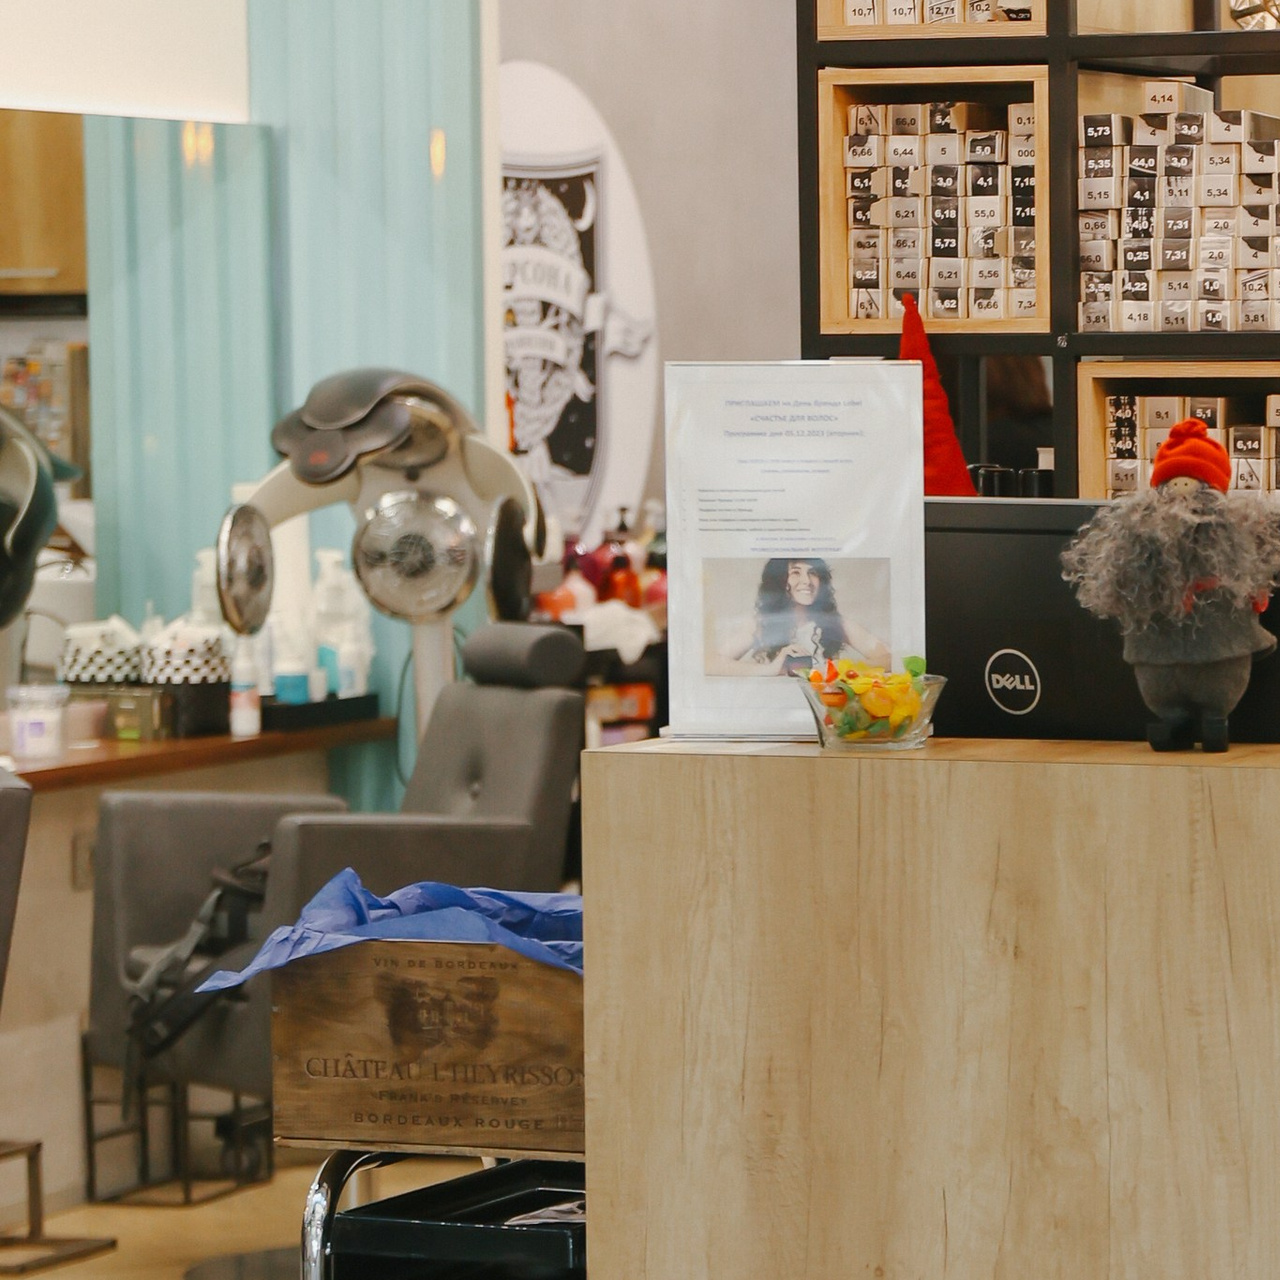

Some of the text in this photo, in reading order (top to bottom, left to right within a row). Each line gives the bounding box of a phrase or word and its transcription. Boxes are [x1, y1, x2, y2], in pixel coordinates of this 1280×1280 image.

[852, 8, 872, 16] 10,7
[893, 8, 913, 16] 10,7
[929, 7, 955, 15] 12,71
[1150, 95, 1173, 104] 4,14
[859, 116, 873, 125] 6,1
[1087, 126, 1110, 138] 5,73
[1150, 129, 1156, 137] 4
[1181, 125, 1199, 136] 3,0
[1224, 125, 1231, 133] 4
[852, 148, 872, 157] 6,66
[893, 148, 913, 157] 6,44
[976, 146, 991, 155] 5,0
[1132, 158, 1155, 168] 44,0
[1172, 157, 1188, 168] 3,0
[1209, 157, 1230, 166] 5,34
[1258, 156, 1264, 164] 4
[1088, 160, 1111, 170] 5,35
[937, 177, 953, 187] 3,0
[977, 177, 992, 186] 4,1
[1014, 178, 1035, 186] 7,18
[1088, 191, 1109, 200] 5,15
[1133, 191, 1149, 201] 4,1
[1168, 189, 1189, 198] 9,11
[1207, 188, 1228, 198] 5,34
[895, 210, 915, 218] 6,21
[935, 209, 956, 218] 6,18
[974, 210, 995, 218] 55,0
[1015, 207, 1035, 216] 7,18
[1085, 221, 1106, 230] 0,66
[1167, 220, 1189, 230] 7,31
[1214, 221, 1229, 230] 2,0
[935, 238, 956, 248] 5,73
[1127, 251, 1149, 262] 0,25
[1165, 251, 1187, 261] 7,31
[1208, 251, 1224, 260] 2,0
[1252, 251, 1258, 259] 4
[856, 271, 877, 280] 6,22
[896, 271, 916, 279] 6,46
[938, 271, 958, 279] 6,21
[979, 270, 999, 278] 5,56
[1168, 282, 1189, 291] 5,14
[1204, 280, 1219, 290] 1,0
[860, 302, 873, 310] 6,1
[935, 300, 957, 309] 6,62
[977, 301, 998, 309] 6,66
[1086, 315, 1107, 324] 3,81
[1128, 313, 1148, 322] 4,18
[1165, 317, 1185, 325] 5,11
[1207, 312, 1222, 322] 1,0
[1244, 314, 1265, 323] 3,81
[1156, 411, 1169, 420] 9,1
[1196, 409, 1212, 418] 5,1
[1236, 440, 1259, 450] 6,14
[1115, 473, 1135, 482] 5,11
[1240, 473, 1253, 482] 6,1
[991, 673, 1035, 690] DELL
[372, 957, 520, 971] VIN DE BORDEAUX
[305, 1052, 422, 1081] CHÂTEAU
[353, 1111, 544, 1131] BORDEAUX ROUGE
